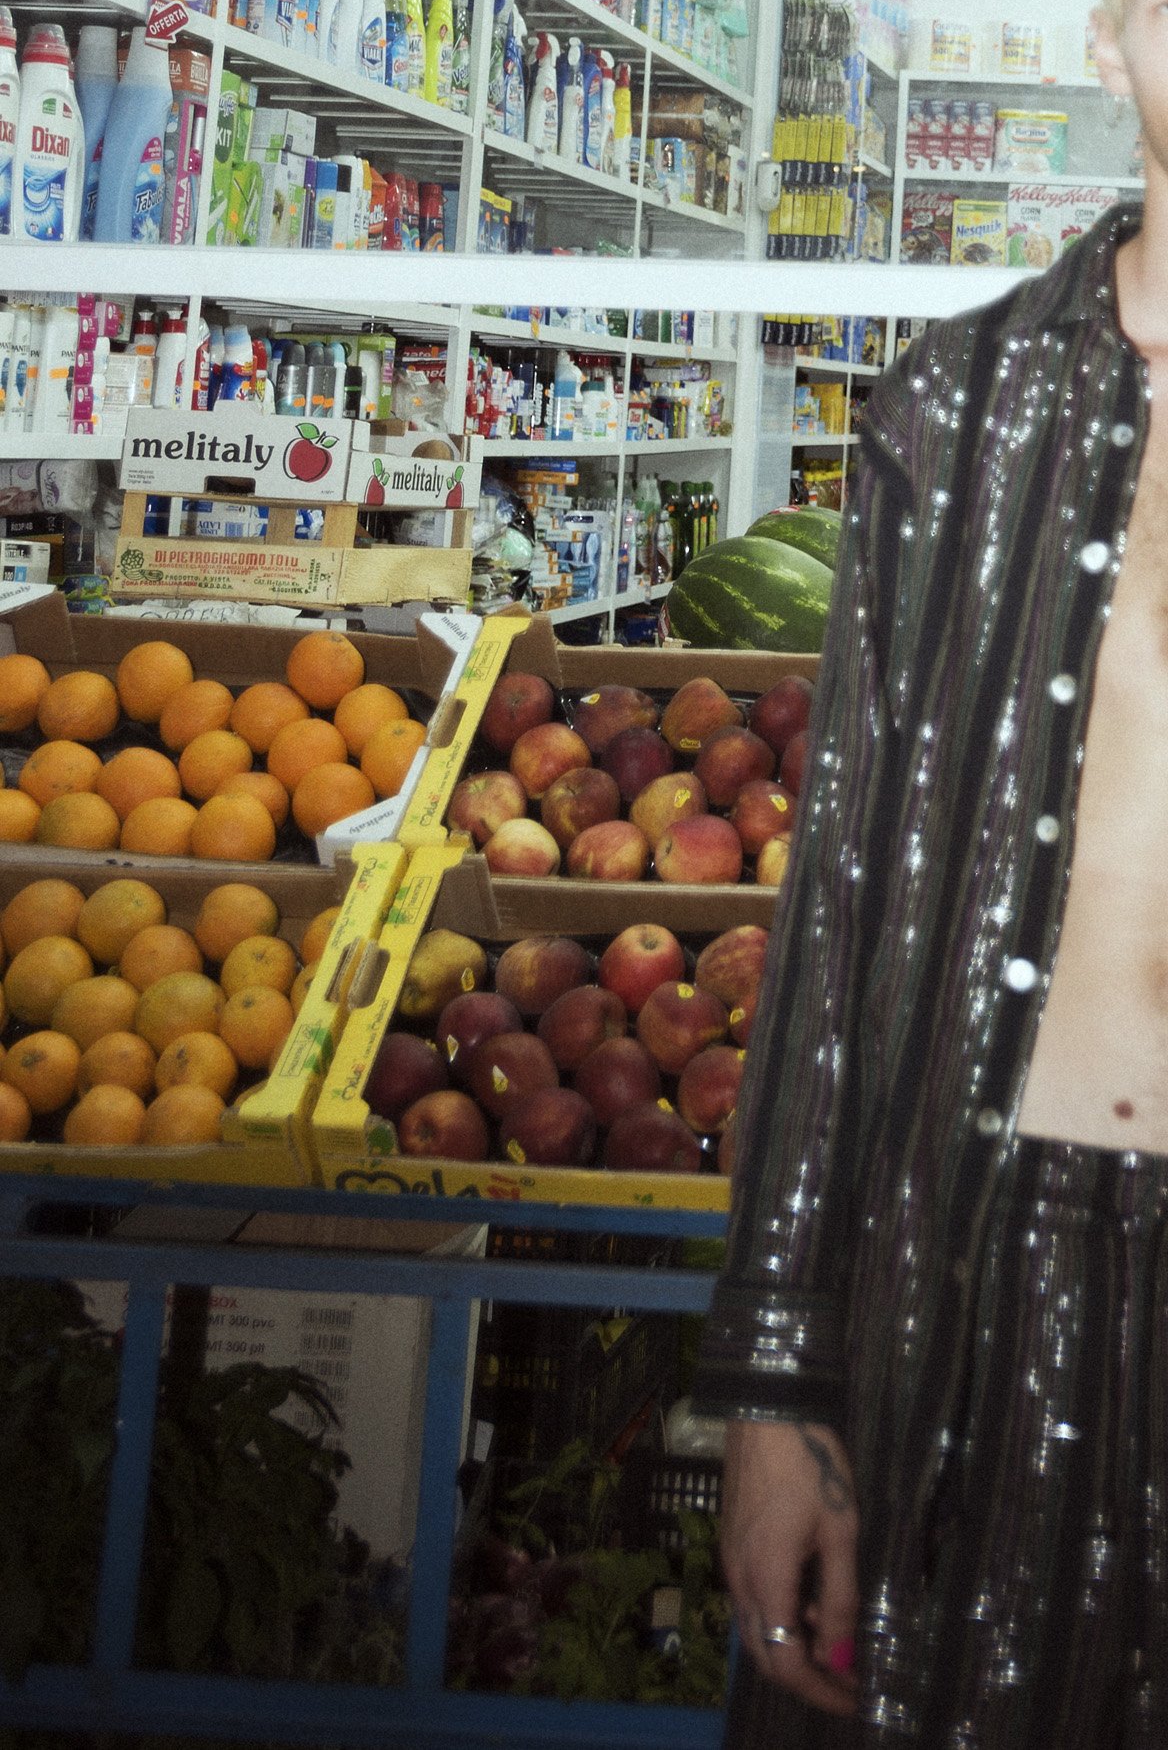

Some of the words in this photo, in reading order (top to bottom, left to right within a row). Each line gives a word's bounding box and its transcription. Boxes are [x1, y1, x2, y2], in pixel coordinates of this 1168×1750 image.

[149, 10, 187, 36] OFFERTA
[31, 125, 70, 157] Dixan
[1020, 206, 1042, 217] CORN
[956, 221, 1002, 239] Nesquik
[131, 431, 274, 471] melitaly
[391, 463, 445, 498] melitaly
[154, 550, 169, 563] DI
[171, 551, 266, 566] PIETROGIACOMO
[227, 1314, 250, 1327] 300
[253, 1317, 275, 1330] pvc
[226, 1341, 247, 1353] 300
